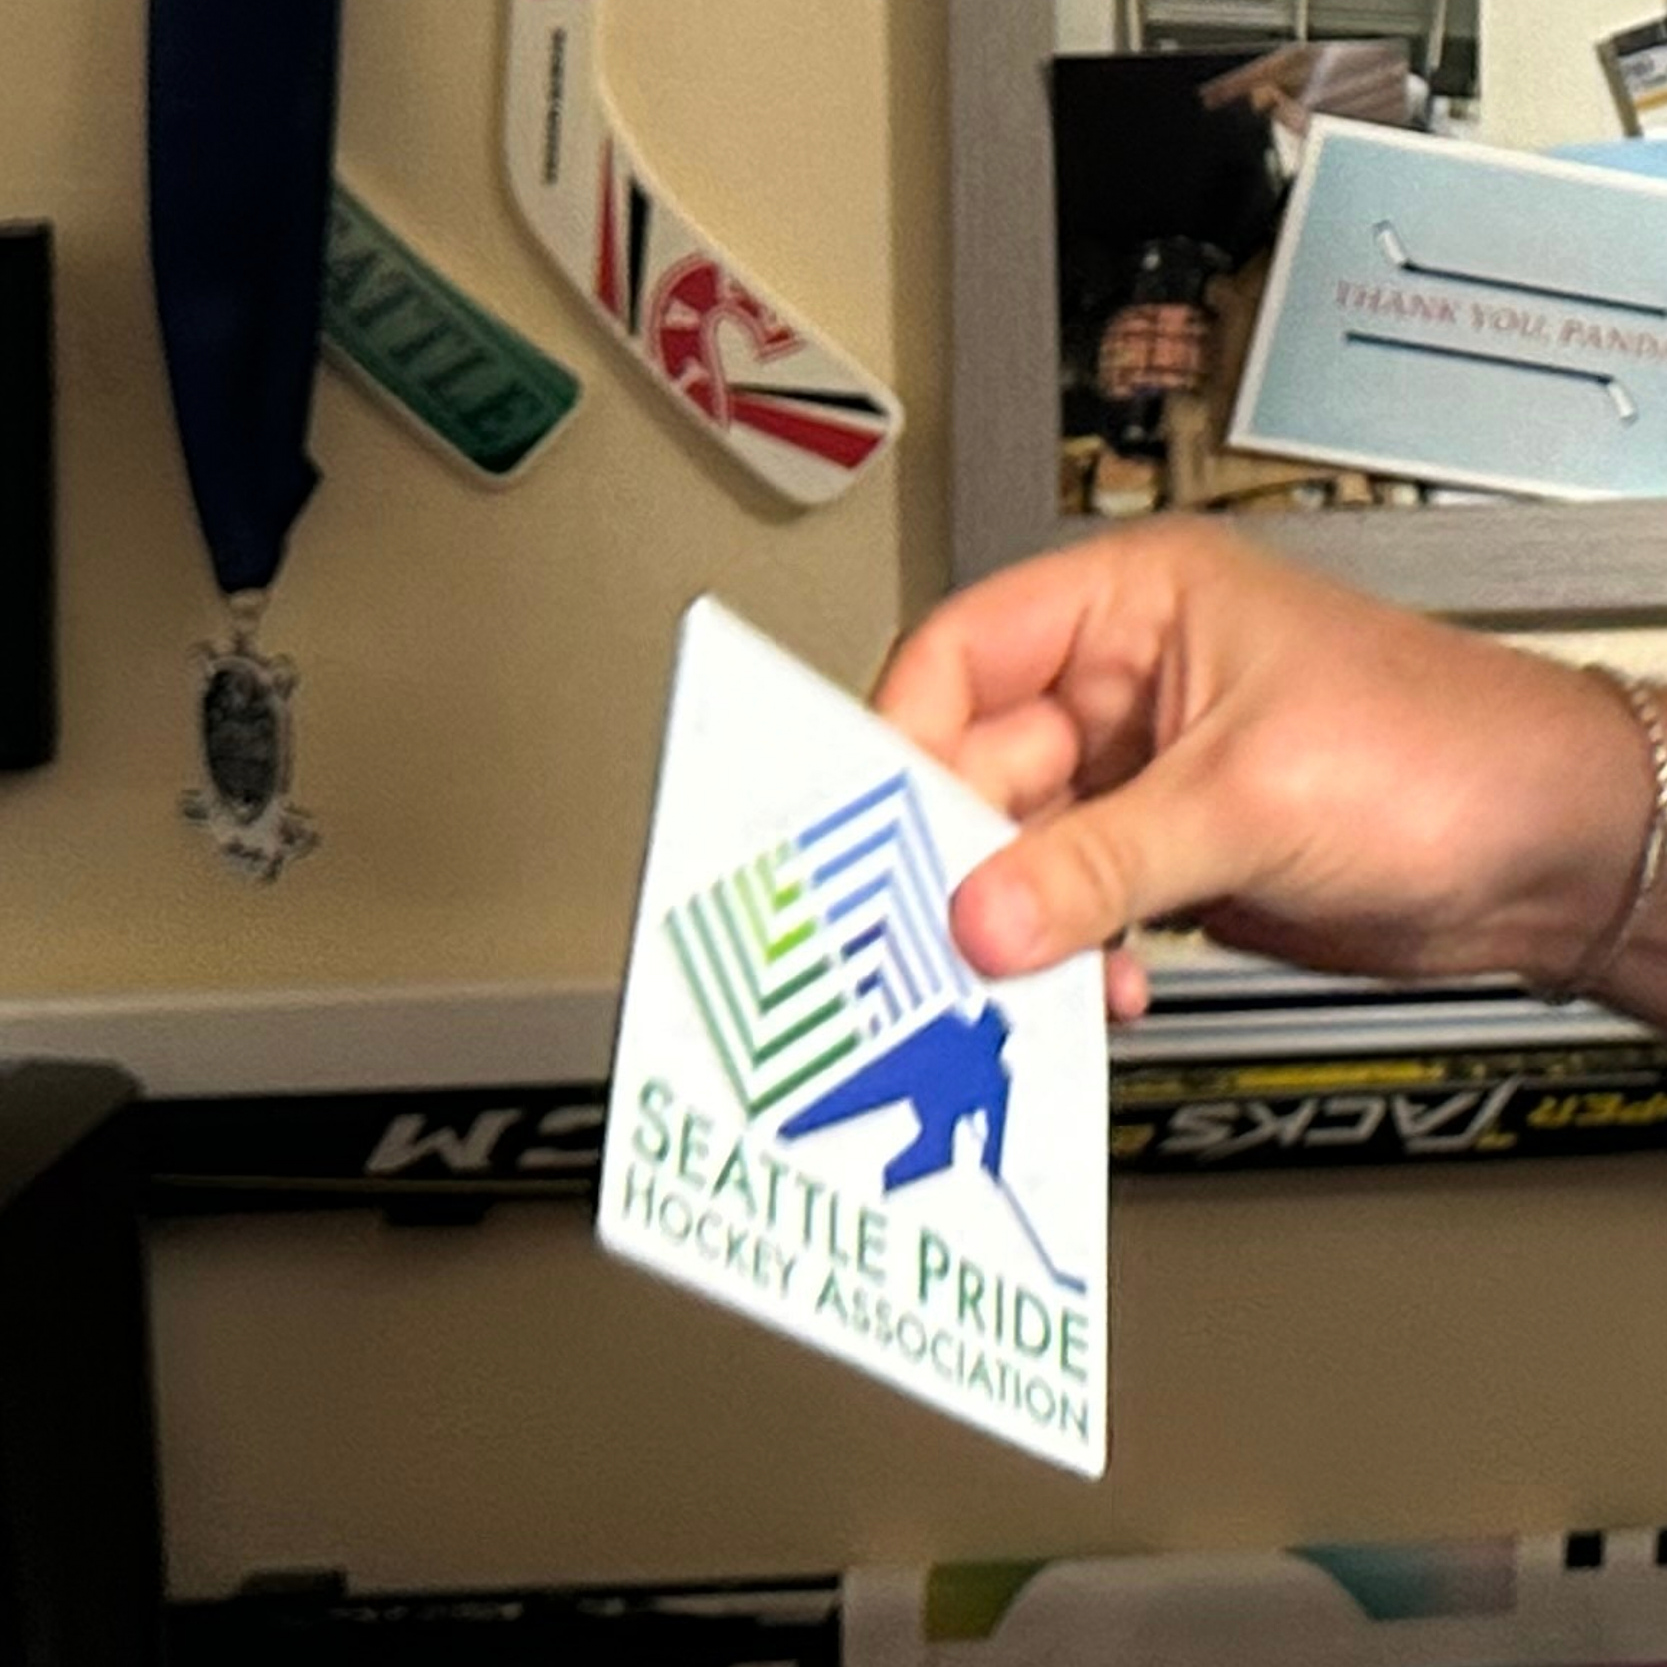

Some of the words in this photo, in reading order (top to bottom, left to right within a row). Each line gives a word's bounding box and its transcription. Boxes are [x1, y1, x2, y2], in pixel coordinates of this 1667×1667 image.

[1334, 279, 1456, 324] THANK
[622, 1163, 797, 1299] HOCKEY
[814, 1268, 1090, 1447] ASSOCIATION
[633, 1077, 888, 1284] SEATTLE
[918, 1226, 1090, 1386] PRIDE
